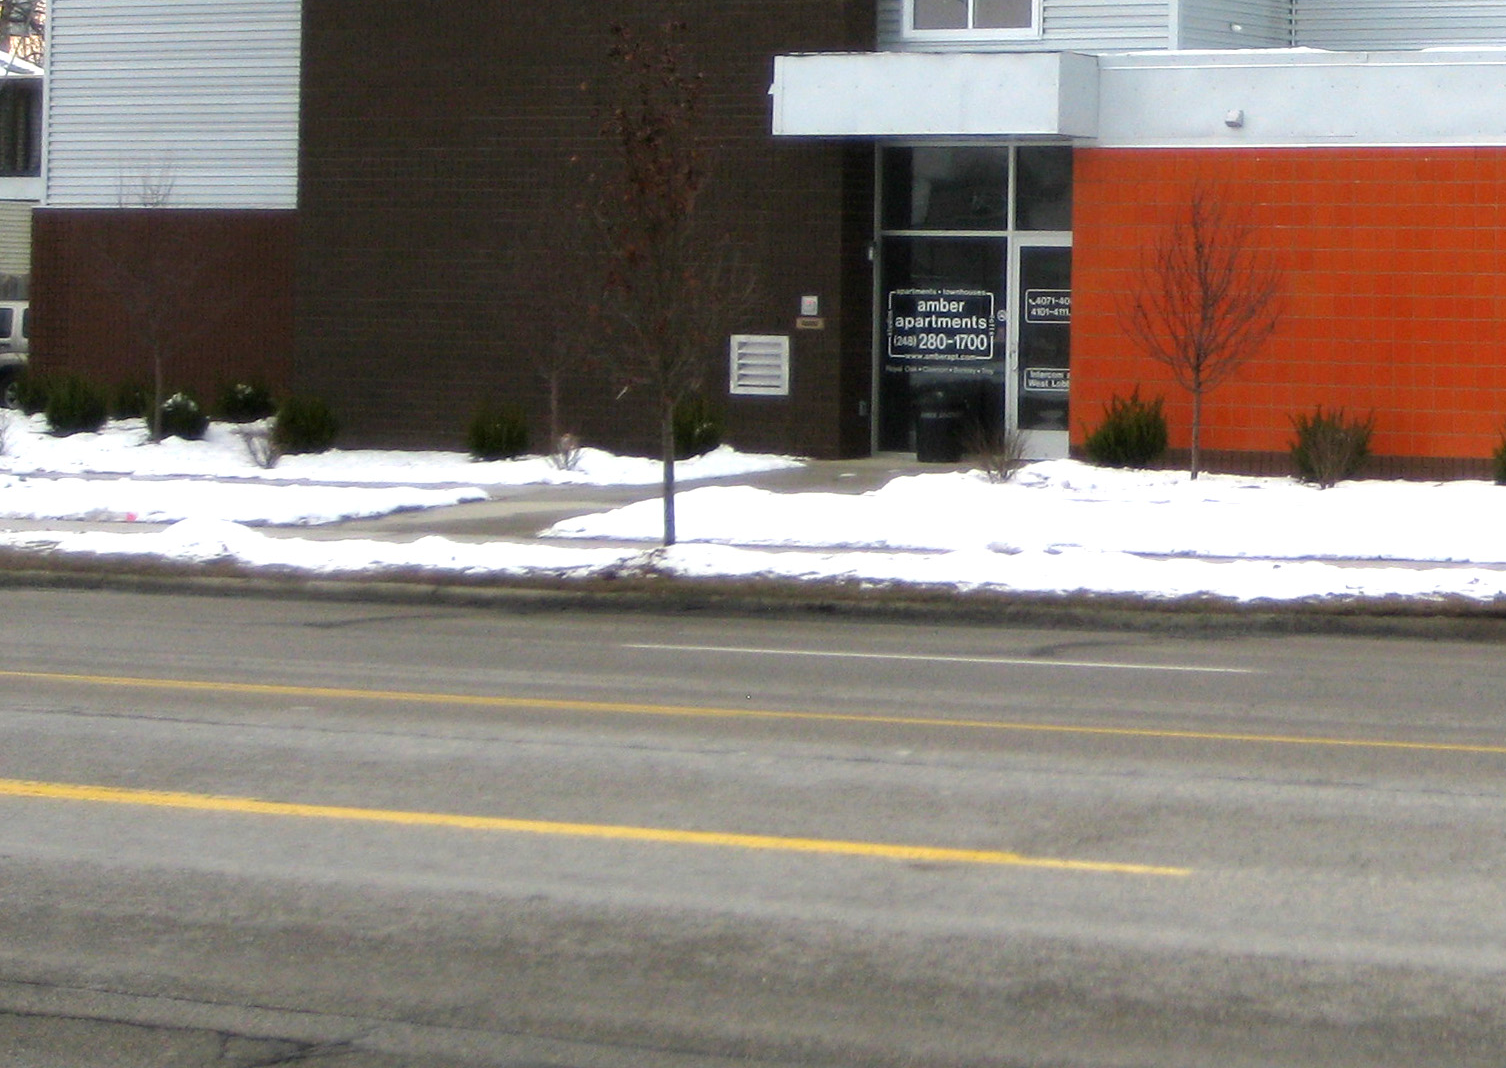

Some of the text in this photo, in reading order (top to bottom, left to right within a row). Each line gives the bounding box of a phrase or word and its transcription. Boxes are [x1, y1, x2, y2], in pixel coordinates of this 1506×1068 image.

[917, 297, 965, 312] amber
[895, 314, 987, 331] apartments
[893, 333, 988, 350] (248) 280-1700
